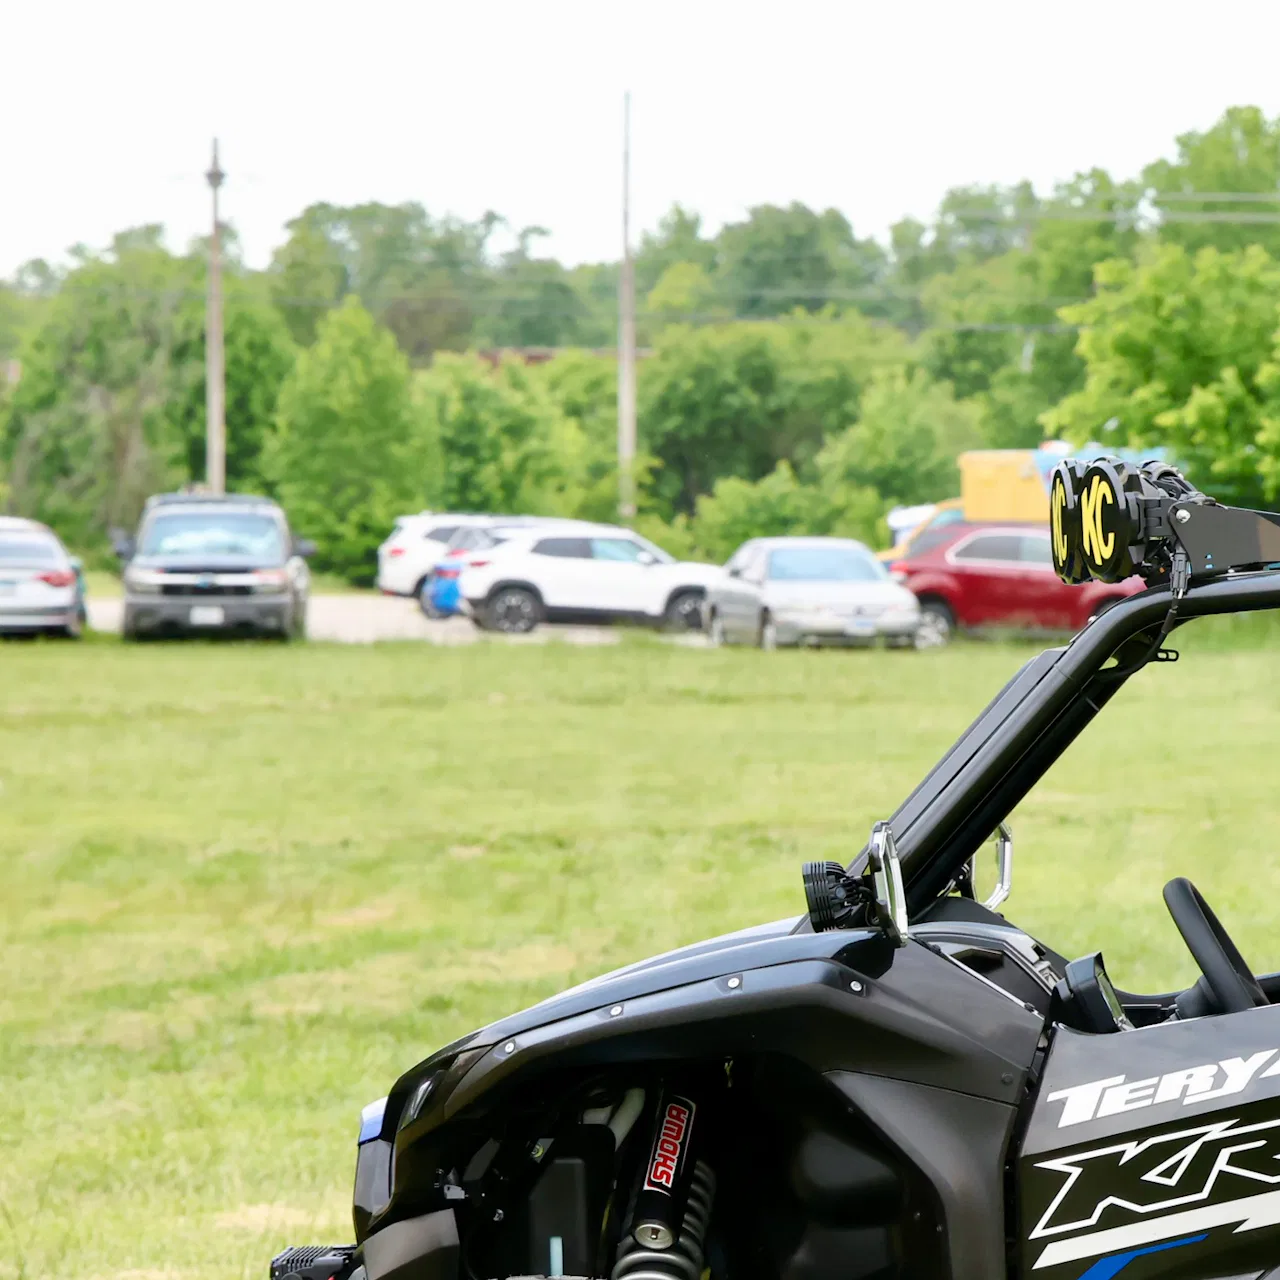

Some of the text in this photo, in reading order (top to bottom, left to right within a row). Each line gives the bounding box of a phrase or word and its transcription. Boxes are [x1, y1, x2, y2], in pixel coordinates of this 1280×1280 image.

[1051, 477, 1068, 567] KC
[1081, 474, 1115, 566] KC
[651, 1103, 689, 1188] SHOWA
